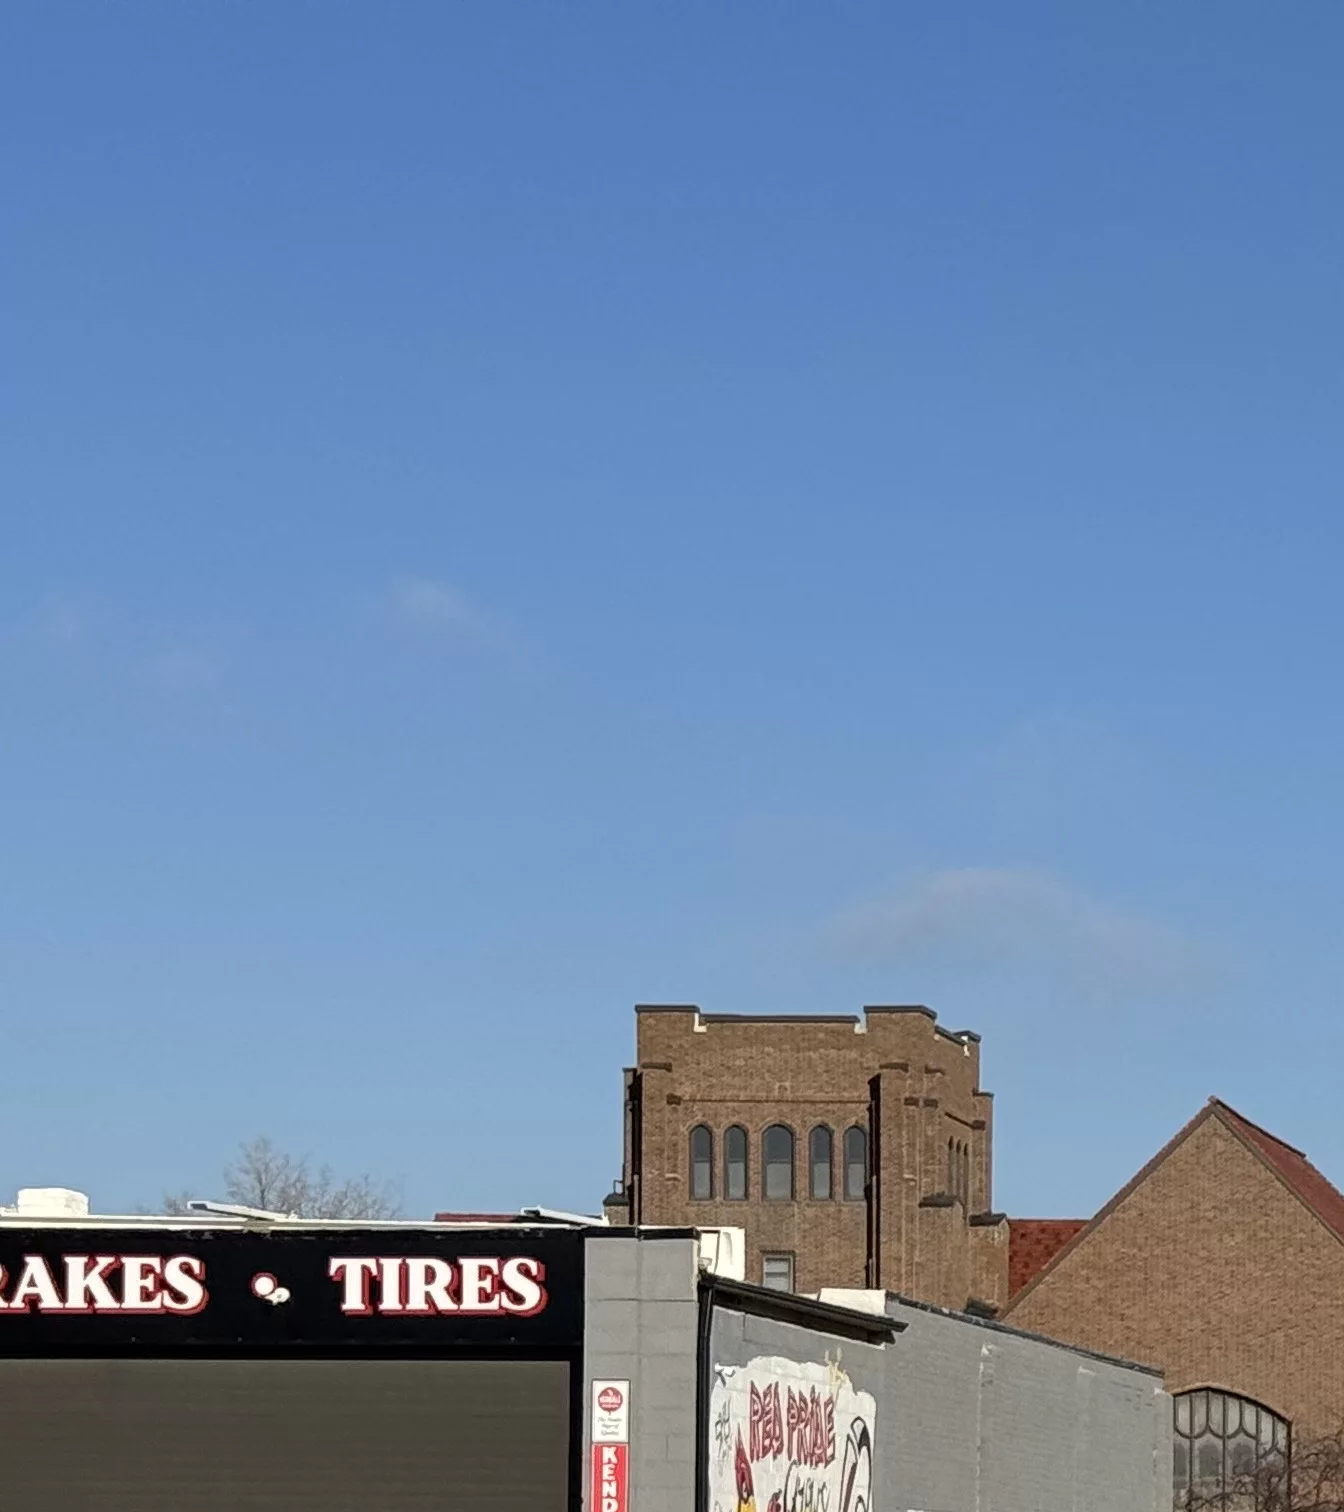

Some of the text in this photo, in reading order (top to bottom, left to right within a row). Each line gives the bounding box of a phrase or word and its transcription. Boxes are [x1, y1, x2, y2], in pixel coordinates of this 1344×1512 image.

[0, 1255, 546, 1317] AKES TIRES
[750, 1380, 784, 1463] RED
[786, 1384, 836, 1470] PRIDE
